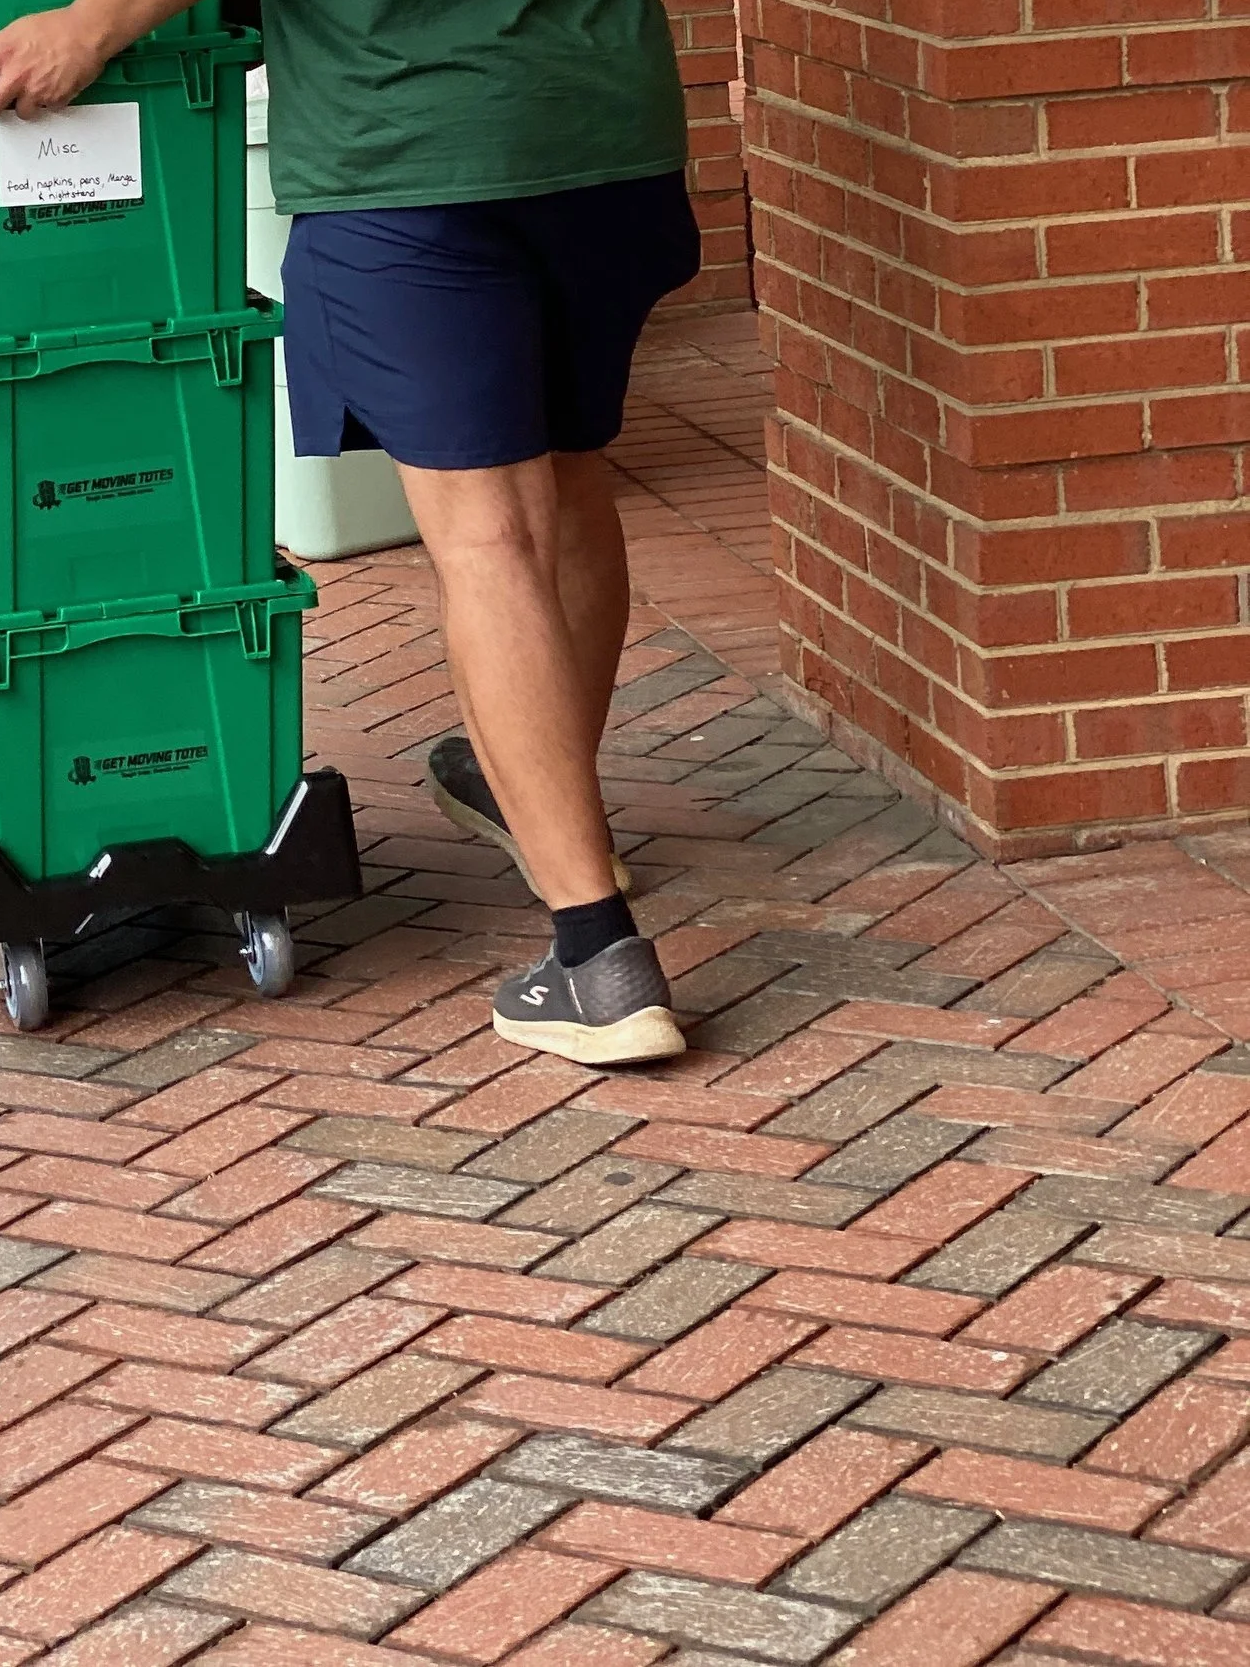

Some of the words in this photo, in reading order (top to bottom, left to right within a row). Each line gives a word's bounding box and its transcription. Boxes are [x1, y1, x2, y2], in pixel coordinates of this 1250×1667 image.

[38, 138, 79, 160] Misc
[7, 178, 33, 192] food,
[36, 176, 76, 191] napkins,
[79, 177, 104, 189] pens,
[37, 206, 61, 220] GET
[66, 480, 90, 494] GET
[91, 473, 137, 491] MOVING
[138, 468, 174, 484] TOTES
[102, 756, 126, 771] GET
[127, 750, 173, 767] MOVING
